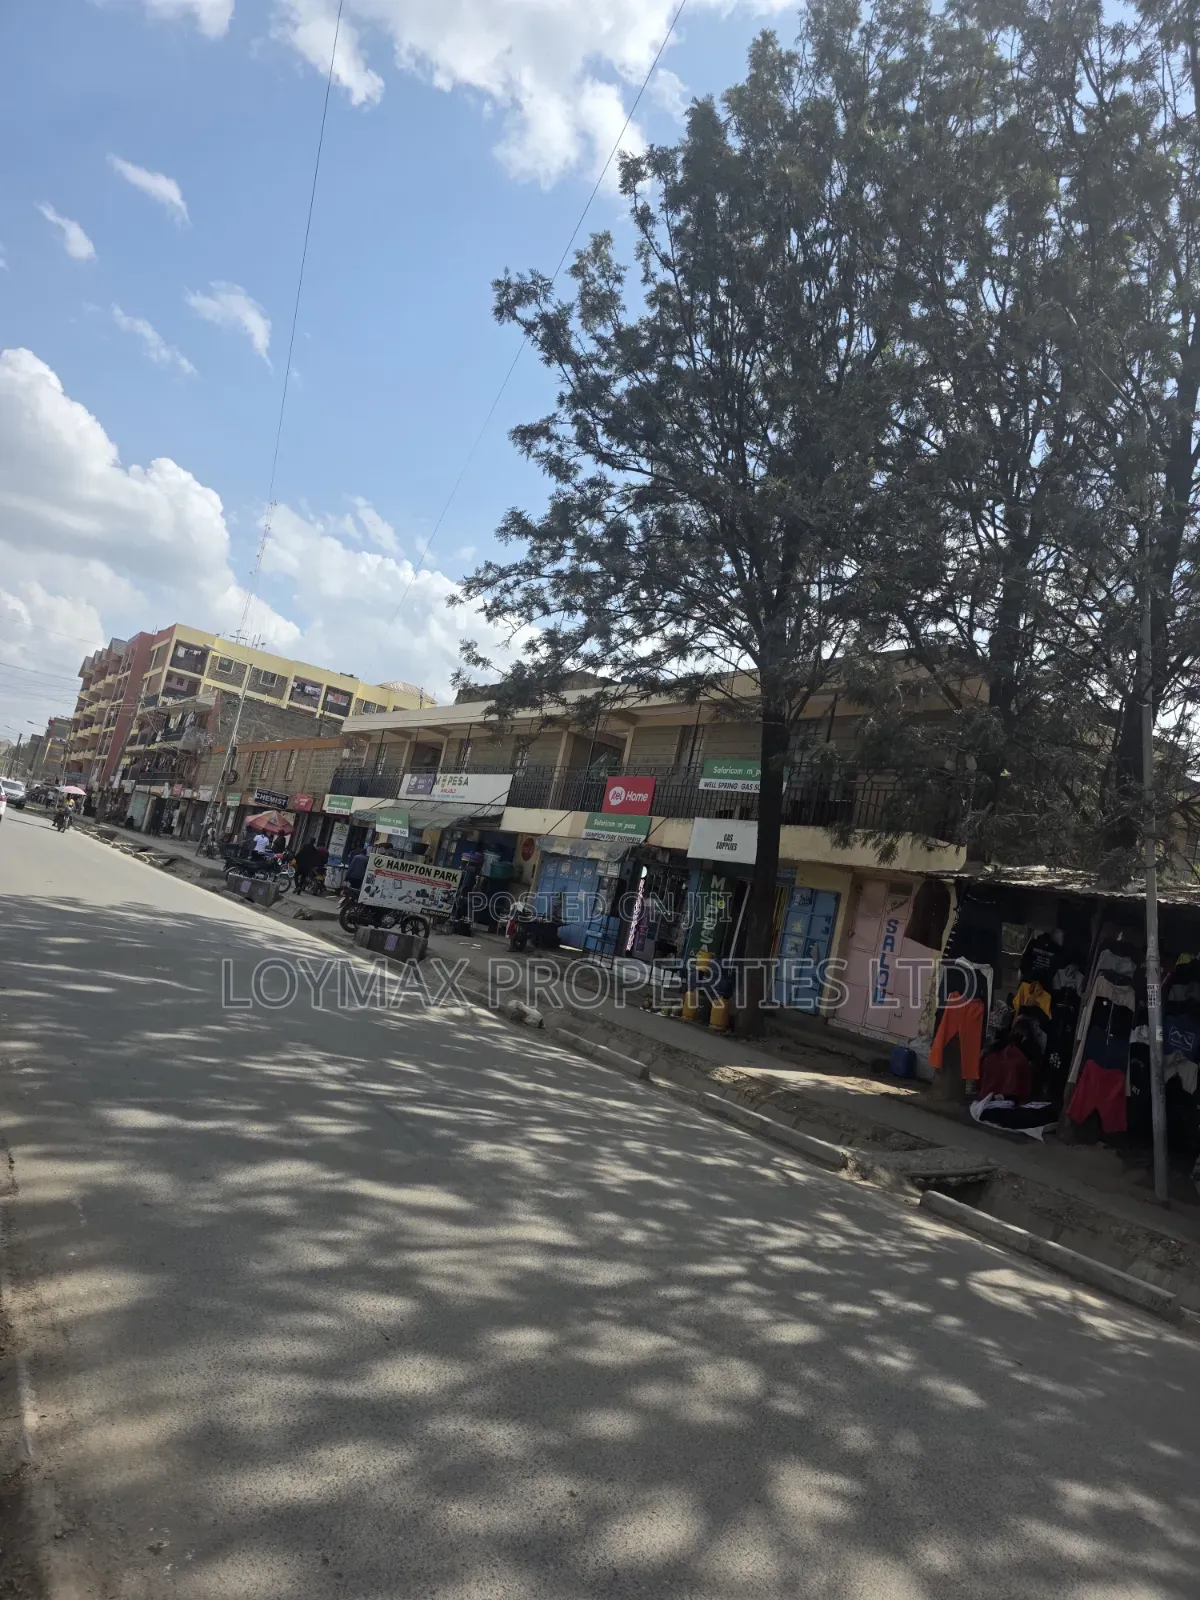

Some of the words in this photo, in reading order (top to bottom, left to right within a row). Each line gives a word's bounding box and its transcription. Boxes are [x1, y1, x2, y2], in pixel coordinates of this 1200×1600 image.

[713, 766, 743, 775] Safaricom
[703, 781, 717, 789] WELL
[718, 782, 739, 790] SPRING
[741, 783, 753, 791] GAS
[255, 793, 287, 806] CHEMIST
[626, 790, 649, 802] Home
[723, 833, 734, 842] GAS
[716, 841, 738, 851] SUPPLIES
[386, 859, 433, 878] HAMPTON
[433, 869, 459, 883] PARK
